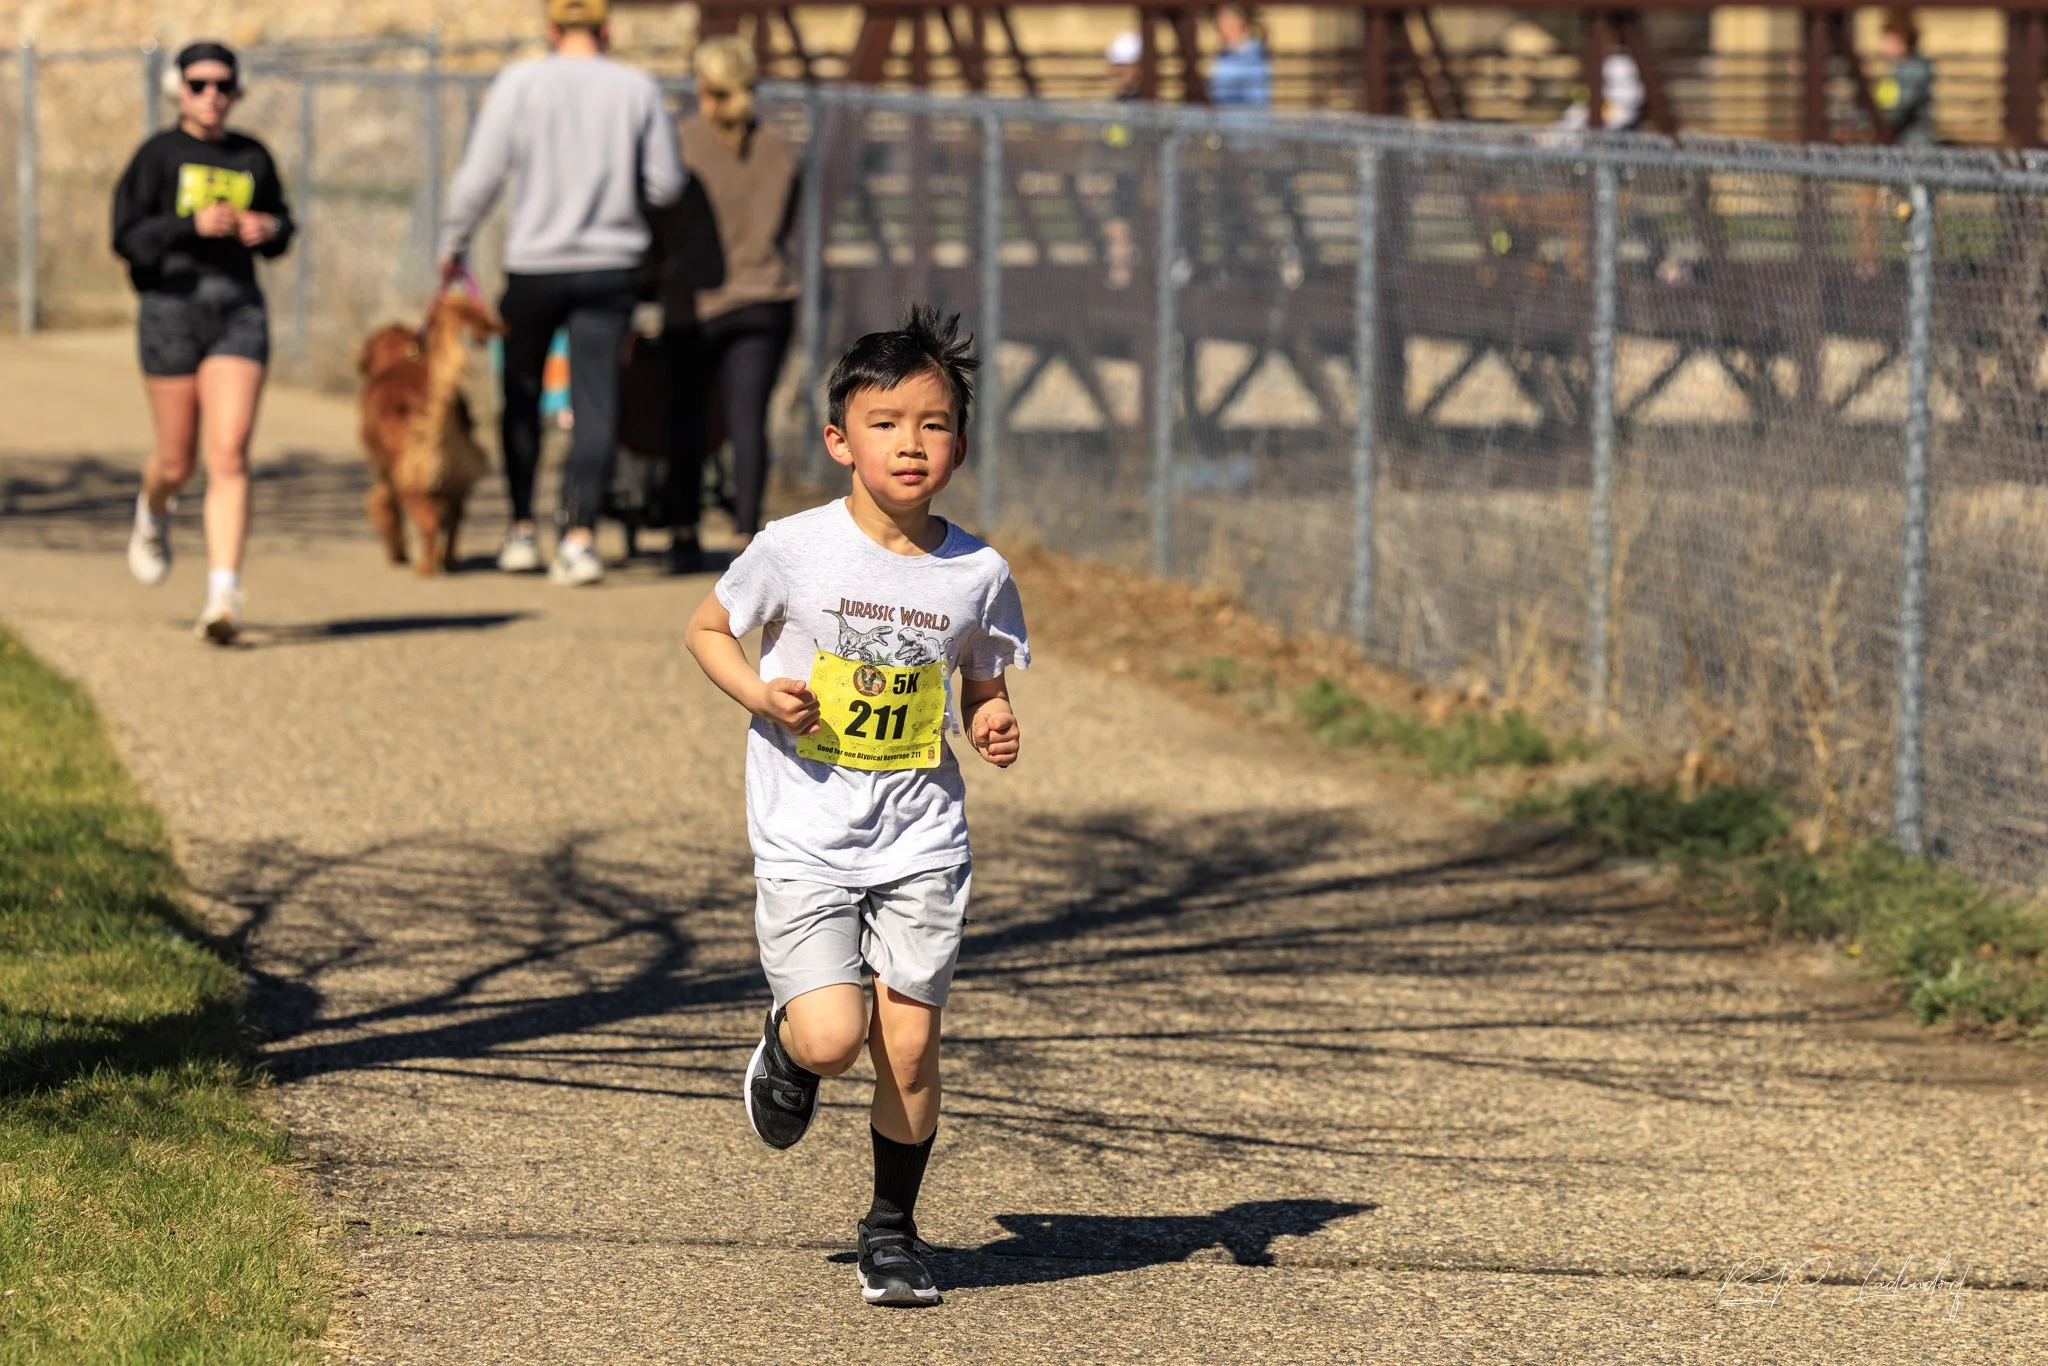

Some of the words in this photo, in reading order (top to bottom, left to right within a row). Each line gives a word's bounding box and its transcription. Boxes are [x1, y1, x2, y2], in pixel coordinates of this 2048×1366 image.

[838, 597, 896, 623] JURASSIC
[900, 606, 951, 632] WORLD
[892, 672, 920, 695] 5K
[844, 699, 909, 740] 211
[817, 744, 833, 753] Good
[833, 747, 843, 756] for
[857, 752, 882, 761] Atypical
[883, 753, 909, 761] Beverage
